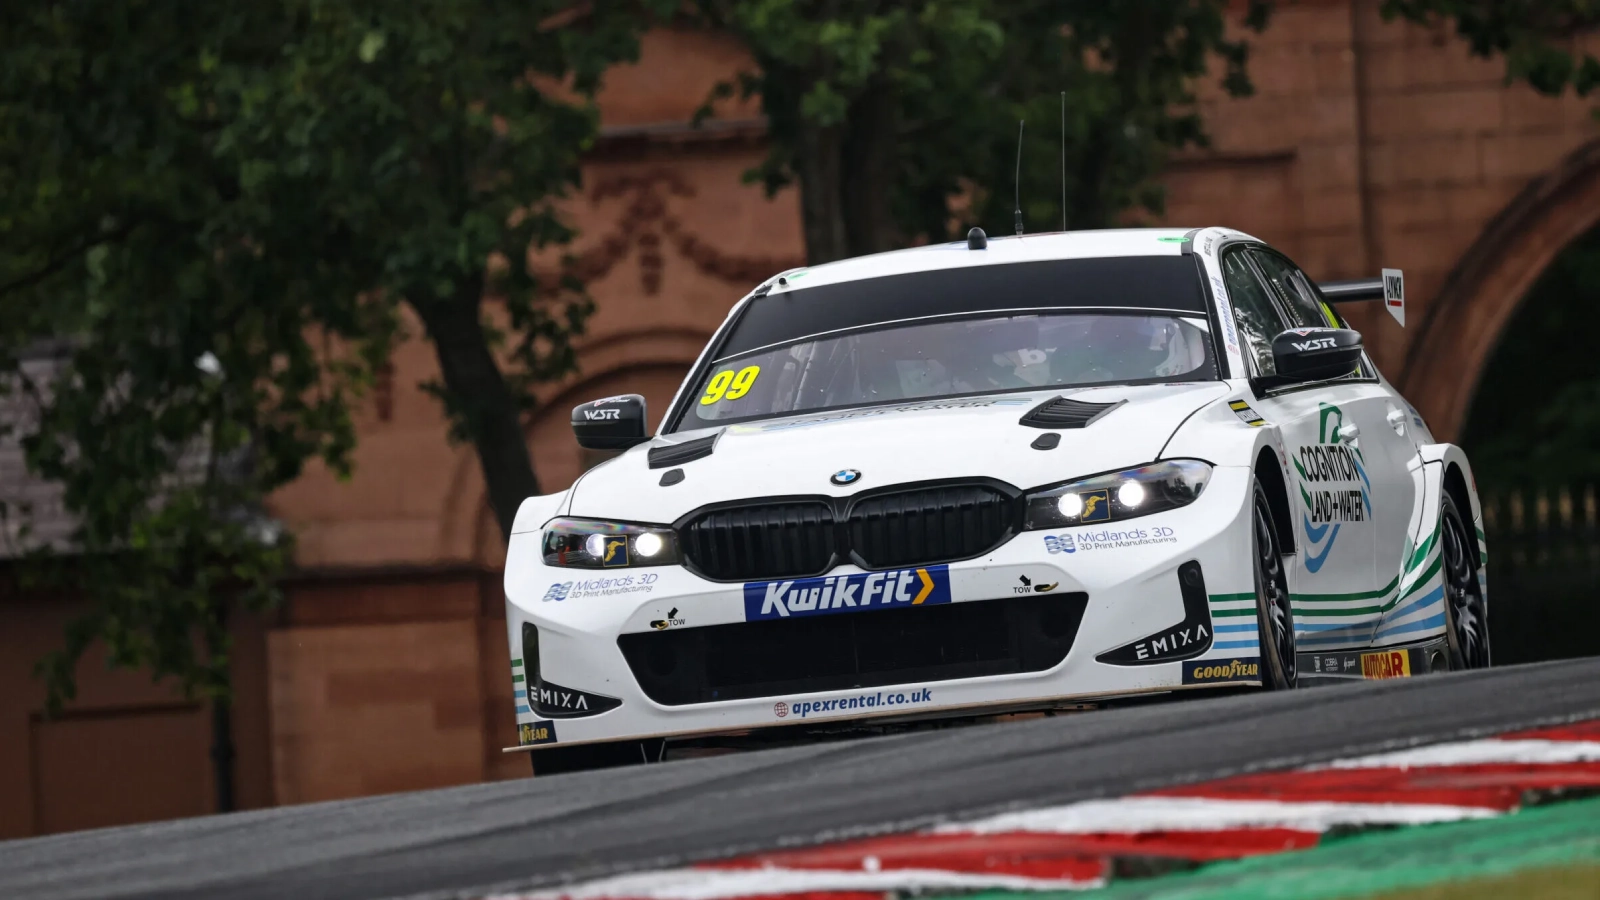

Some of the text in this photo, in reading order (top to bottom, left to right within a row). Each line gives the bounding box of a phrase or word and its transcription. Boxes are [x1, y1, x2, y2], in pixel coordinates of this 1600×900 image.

[1291, 337, 1338, 352] WSR
[700, 365, 761, 406] 99
[583, 408, 621, 421] WSR
[1299, 445, 1361, 482] COGNITION
[1077, 526, 1174, 542] Midlands 3D
[1080, 537, 1177, 551] 3D Print Manufacturing
[574, 573, 658, 591] Midlands 3D
[1013, 586, 1032, 594] TOW
[569, 584, 653, 599] 3D Print Manufacturing
[668, 618, 686, 626] TOW
[1135, 623, 1209, 660] EMIXA
[1363, 651, 1404, 679] AUTOCAR
[530, 685, 589, 711] EMIXA
[792, 687, 932, 718] apexrental.co.uk
